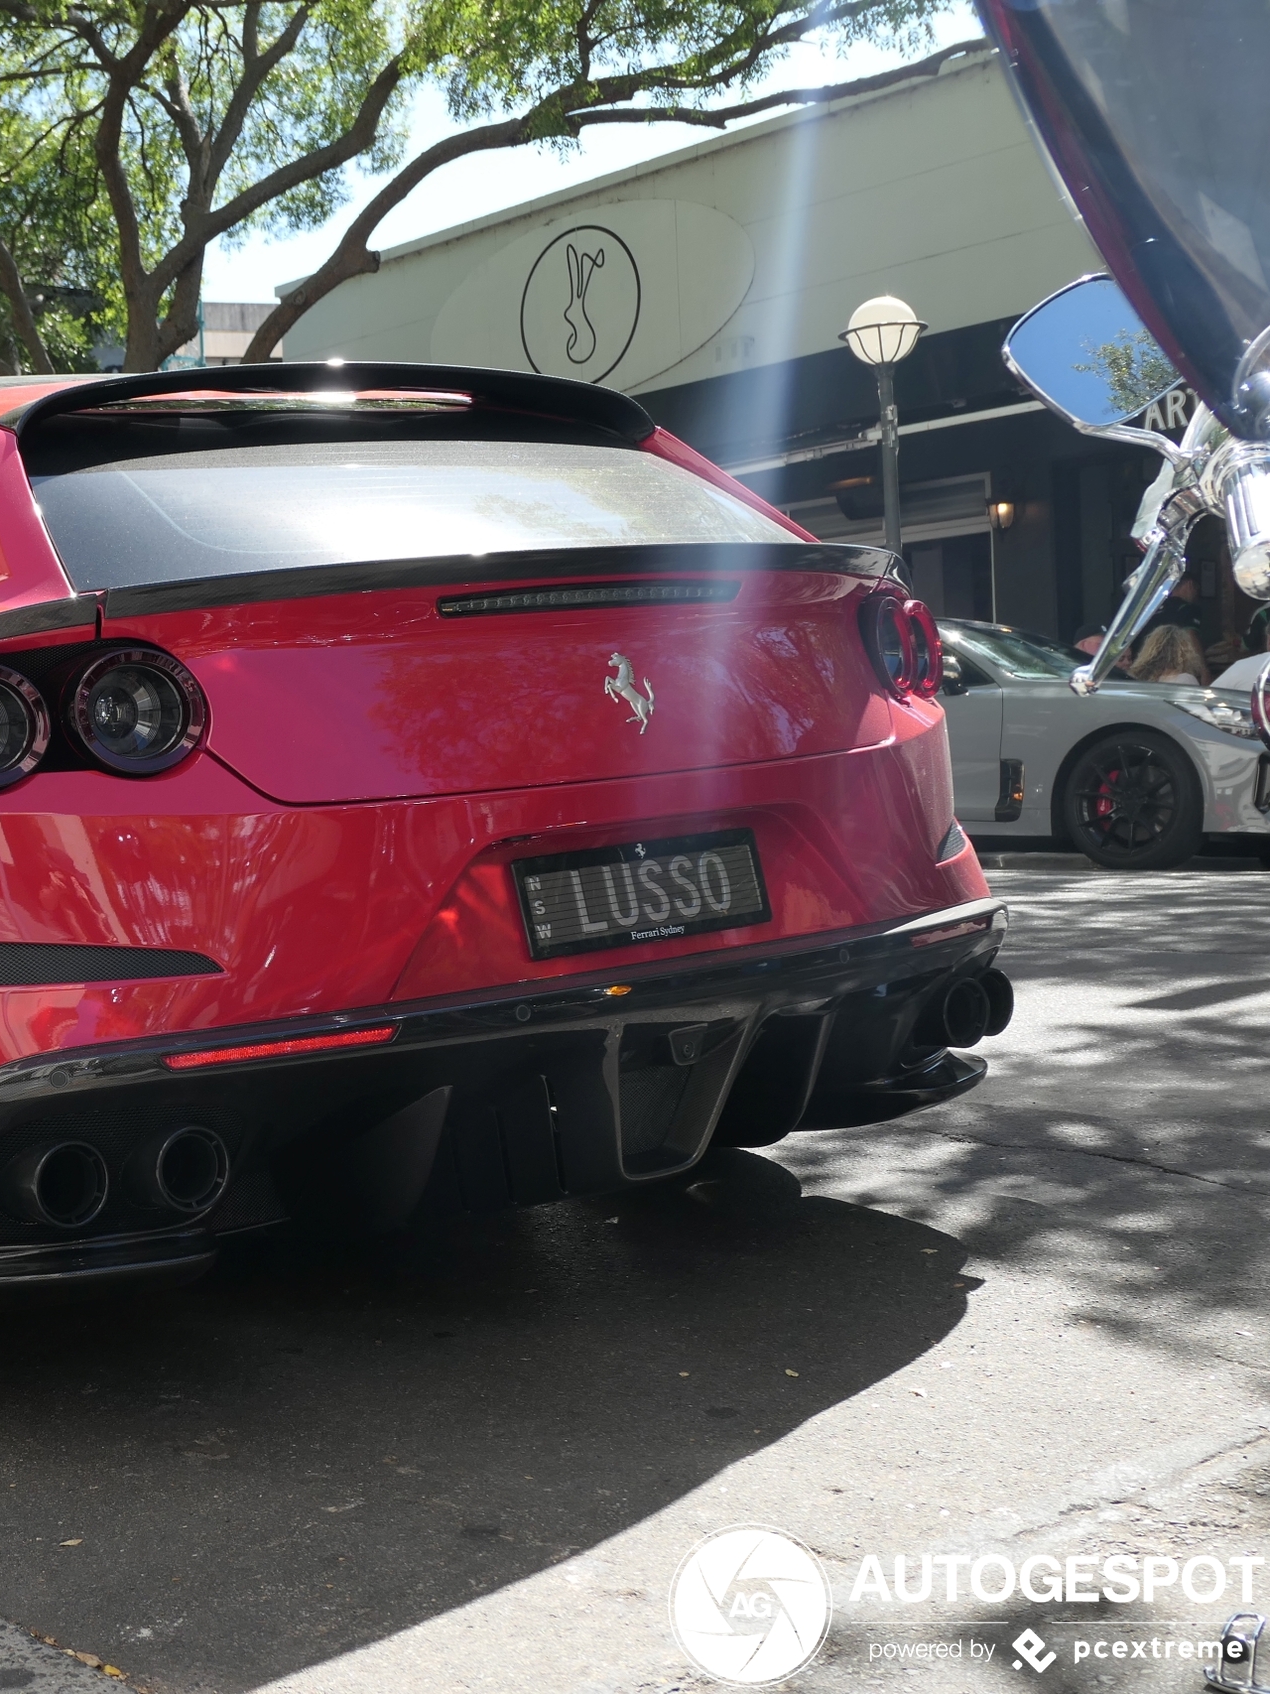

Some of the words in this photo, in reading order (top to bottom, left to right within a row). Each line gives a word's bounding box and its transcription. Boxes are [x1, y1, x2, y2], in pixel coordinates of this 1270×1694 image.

[570, 851, 732, 933] LUSSO
[630, 927, 660, 940] Ferrari
[660, 924, 685, 937] Sydney
